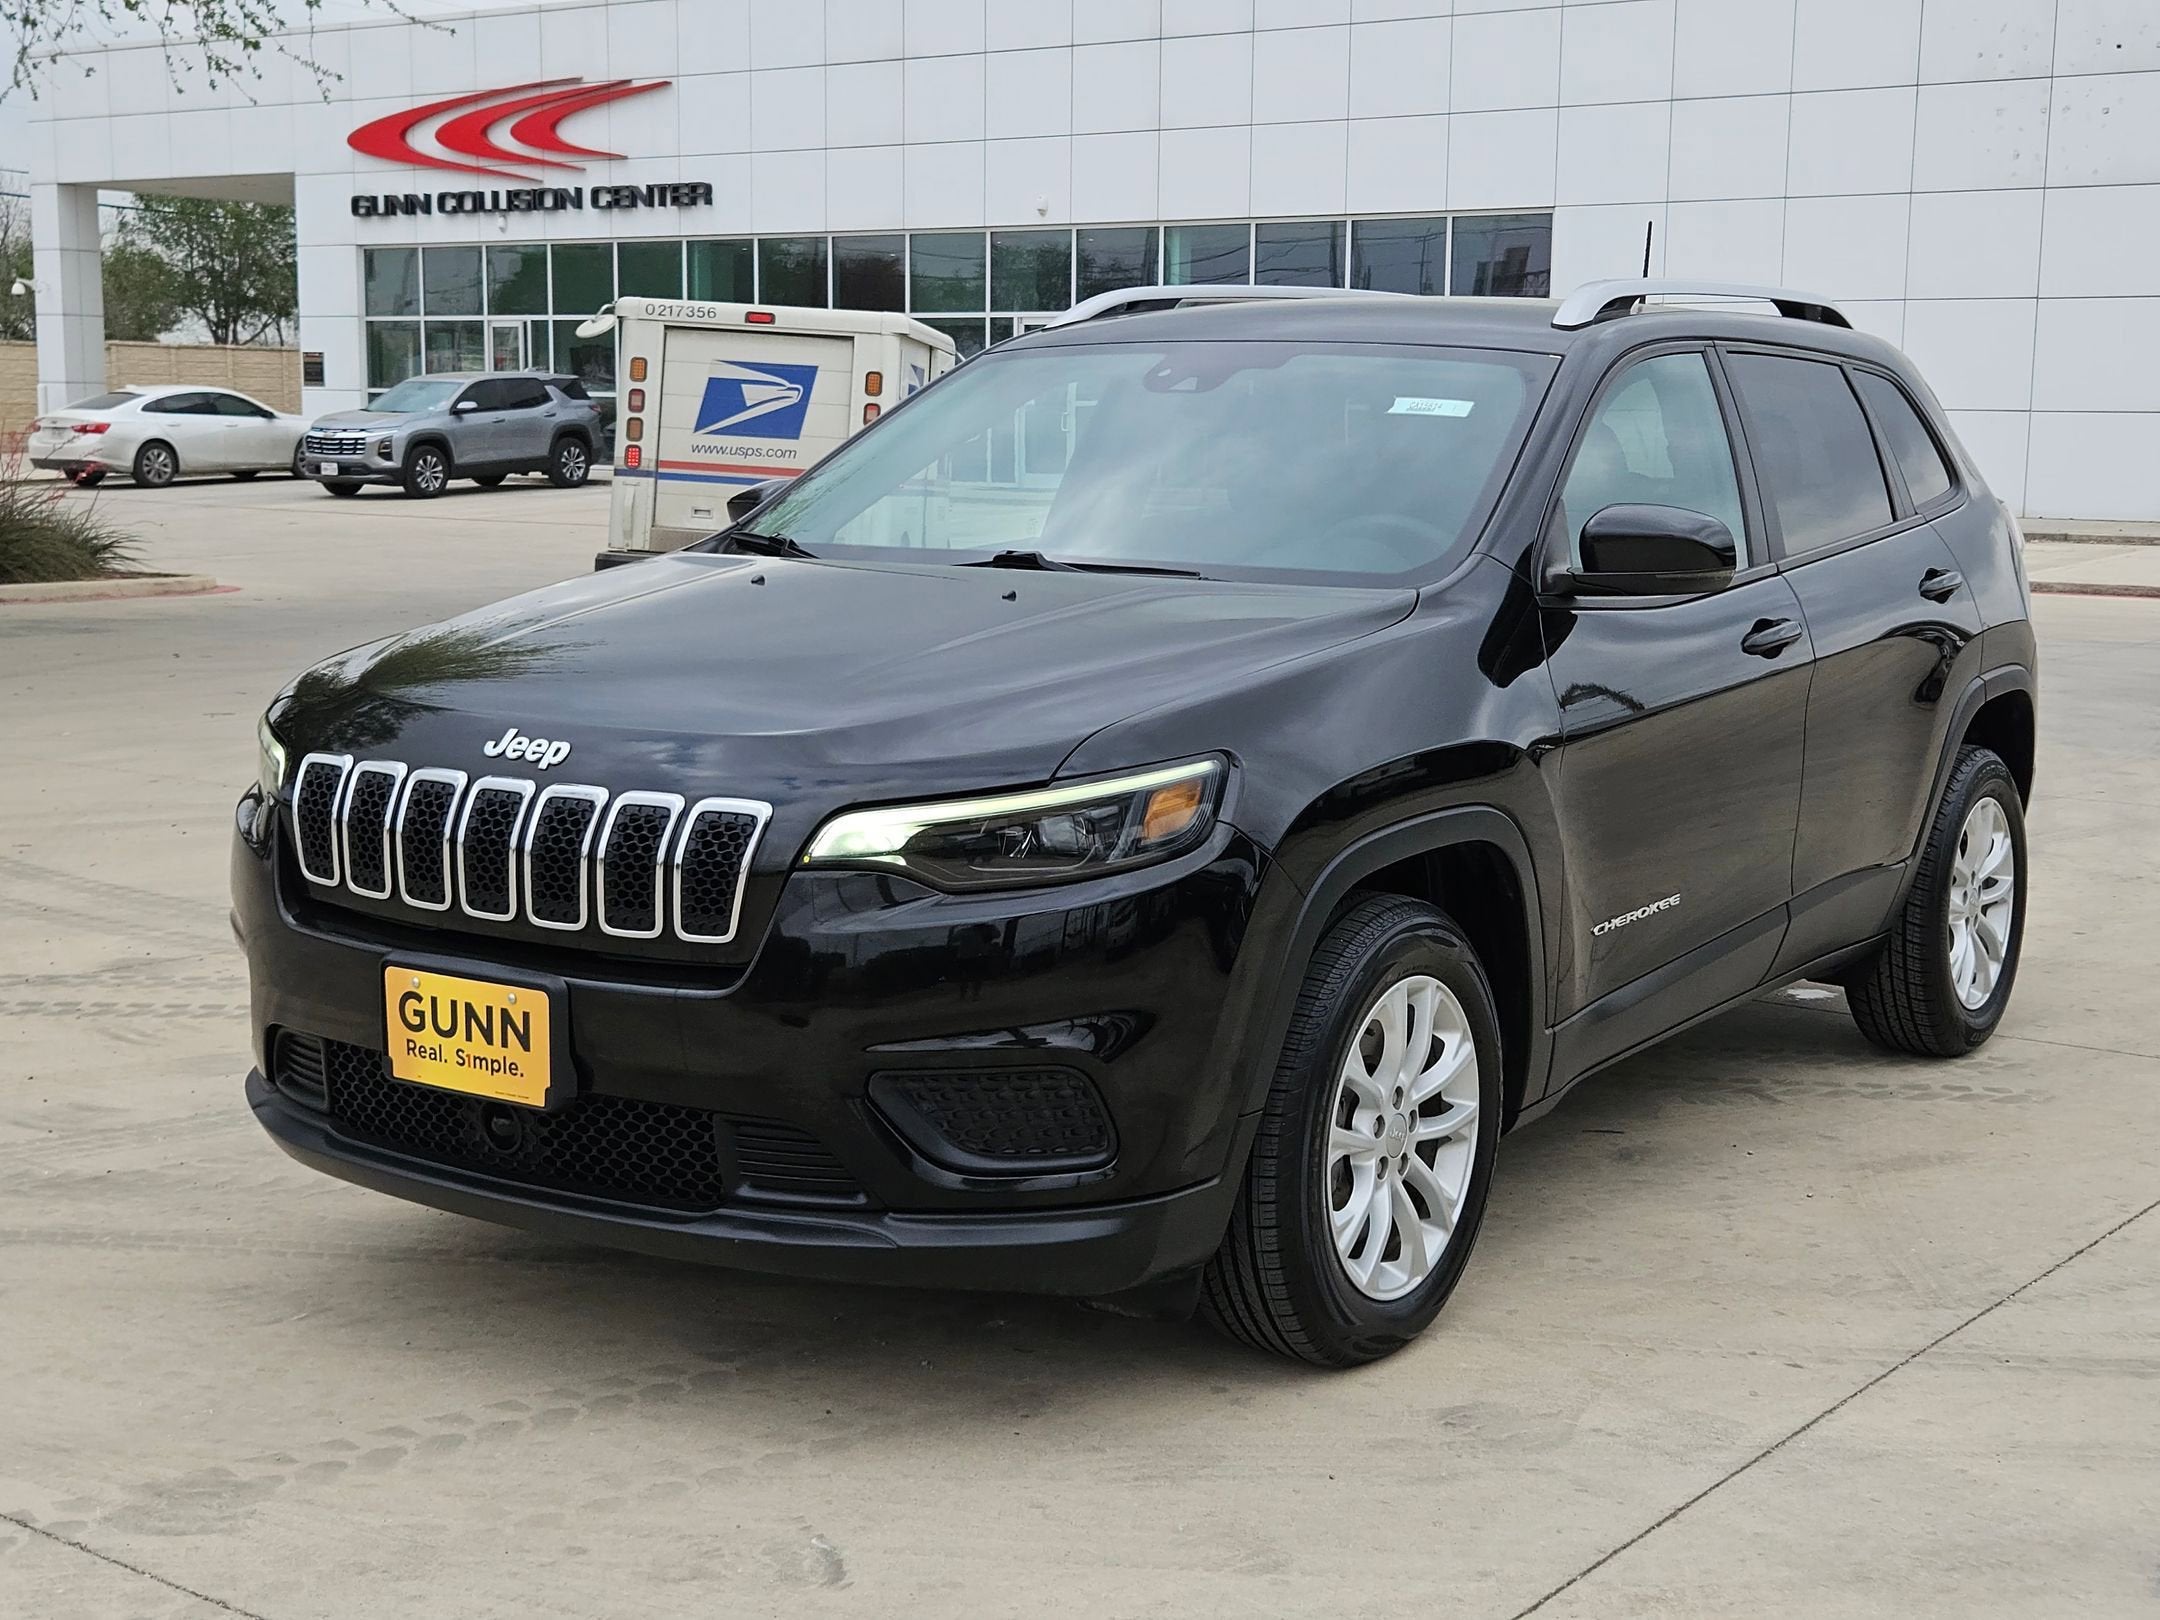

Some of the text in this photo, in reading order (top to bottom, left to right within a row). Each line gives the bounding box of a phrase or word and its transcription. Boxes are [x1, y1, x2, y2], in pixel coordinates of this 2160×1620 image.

[351, 181, 713, 217] GUNN COLLISION CENTER
[645, 303, 718, 319] 0217356
[691, 444, 798, 459] www.usps.com
[483, 728, 571, 770] Jeep
[1591, 892, 1681, 936] CHEROKEE
[398, 990, 531, 1053] GUNN
[406, 1038, 448, 1064] Real.
